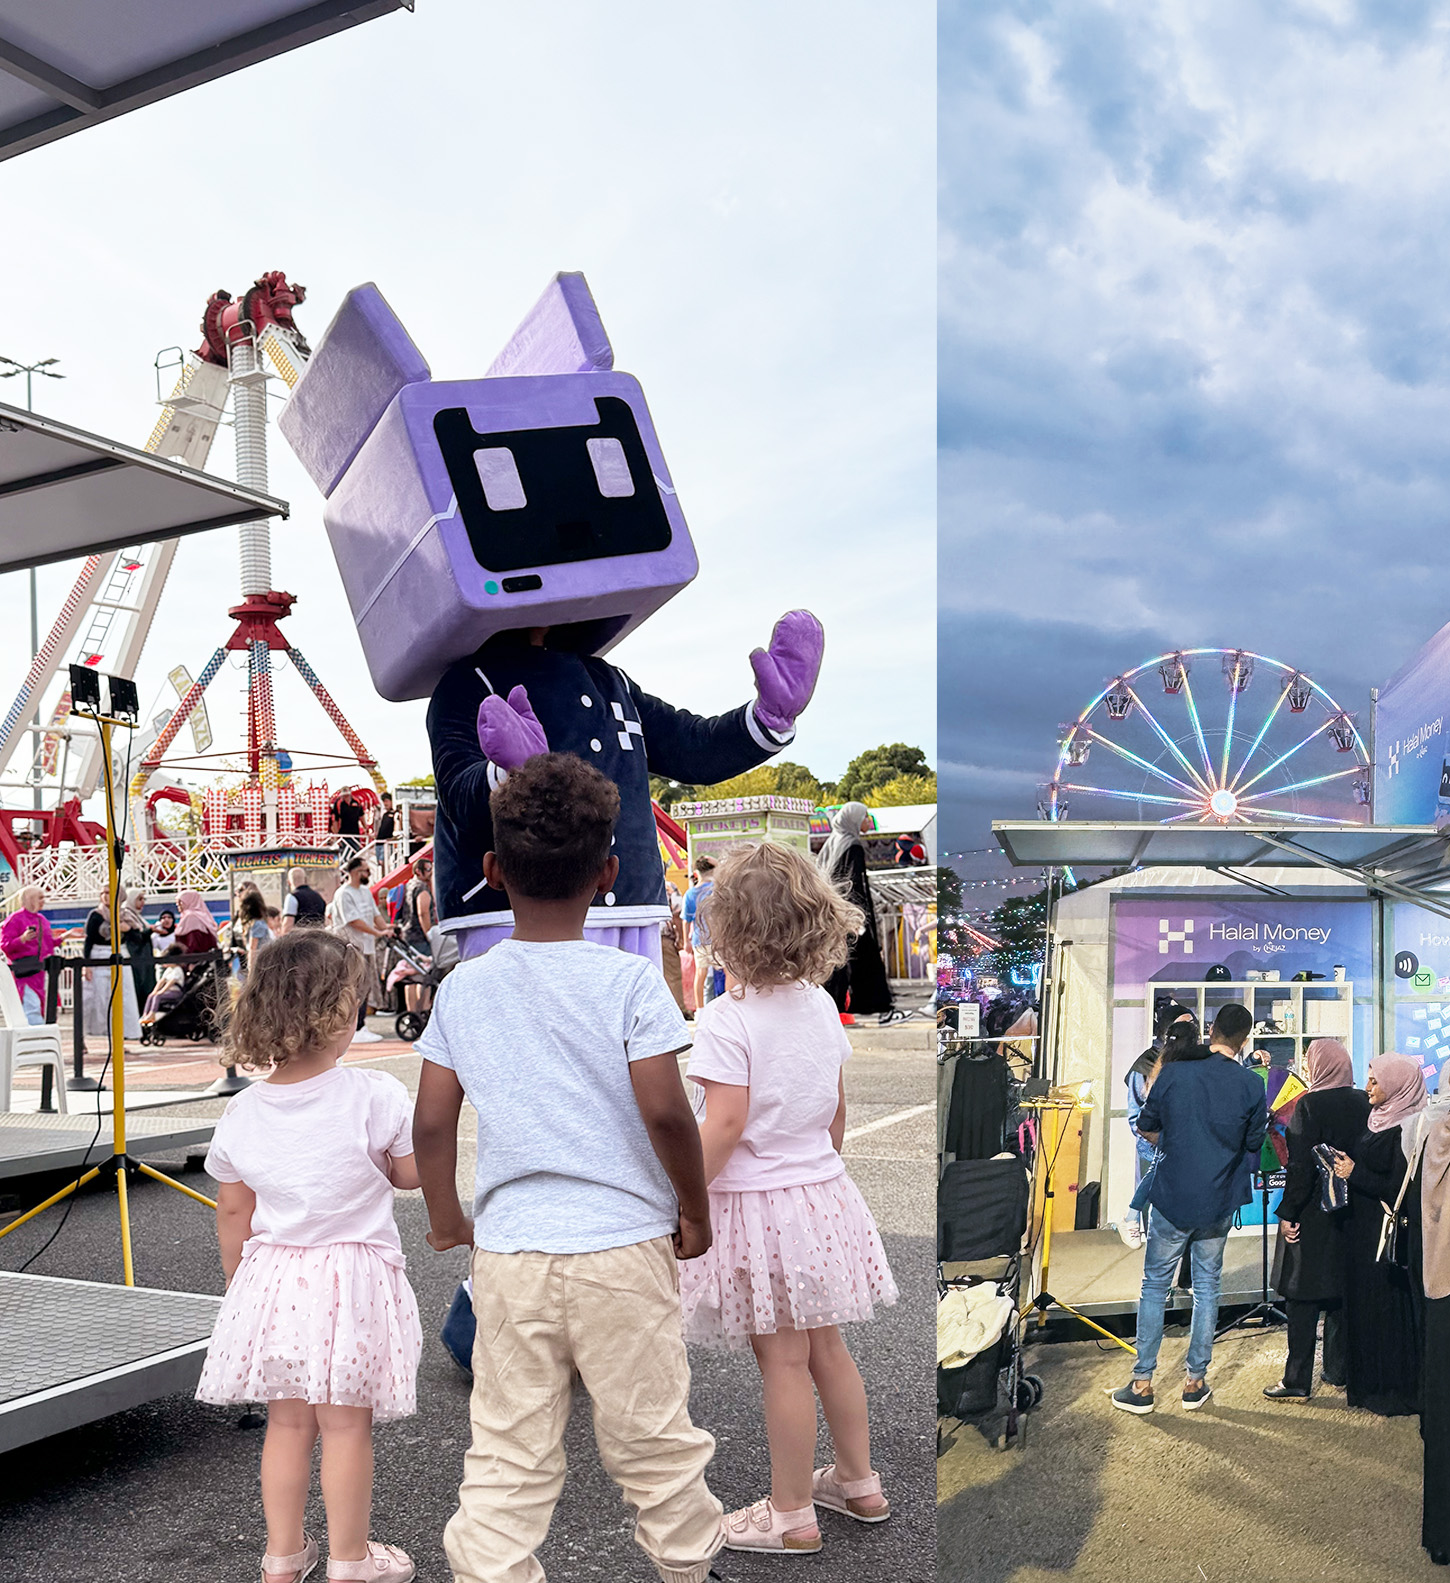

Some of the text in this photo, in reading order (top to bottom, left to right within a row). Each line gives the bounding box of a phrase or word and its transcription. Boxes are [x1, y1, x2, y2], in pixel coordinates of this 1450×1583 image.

[170, 667, 212, 749] KAKAZE
[695, 817, 760, 833] TICKETS
[236, 853, 281, 868] TICKETS
[294, 852, 335, 865] TICKETS
[1209, 922, 1332, 945] Halal Money
